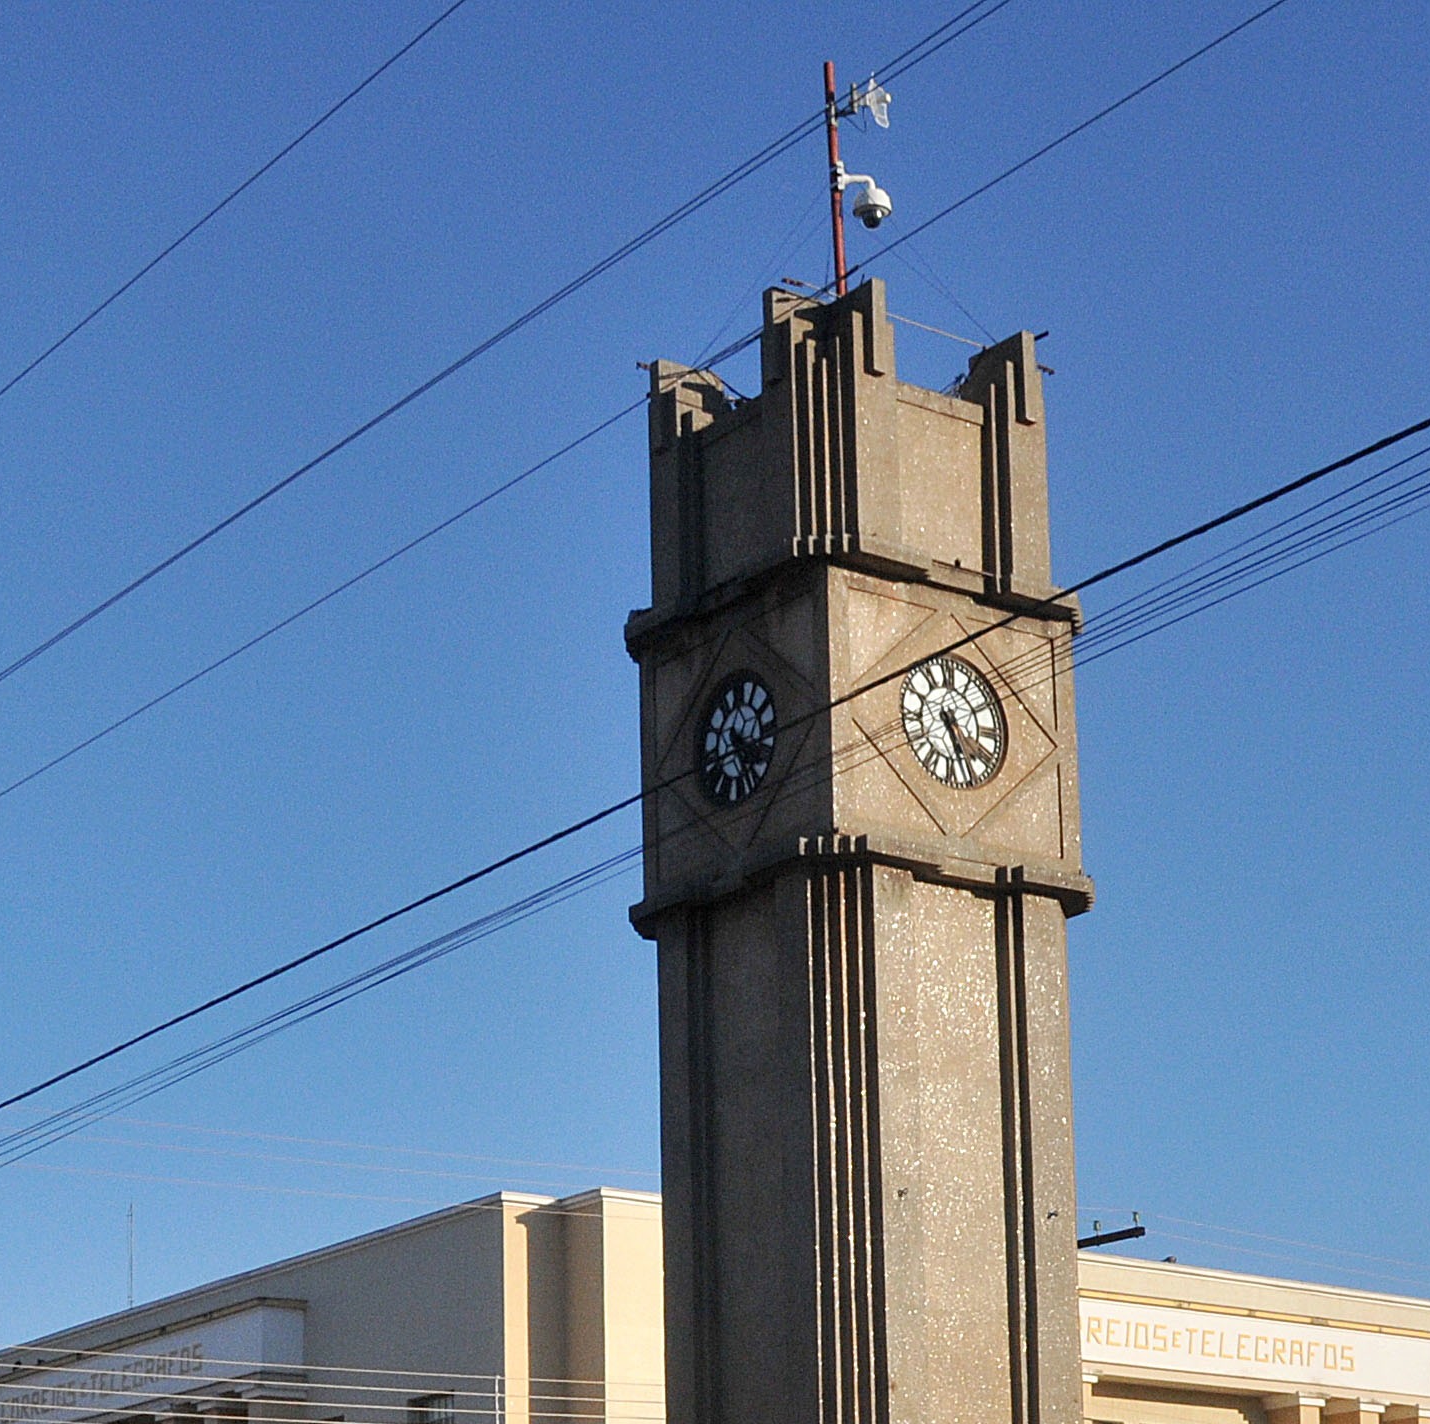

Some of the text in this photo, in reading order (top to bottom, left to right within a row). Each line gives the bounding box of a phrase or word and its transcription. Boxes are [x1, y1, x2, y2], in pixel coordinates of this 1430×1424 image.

[1086, 1316, 1356, 1373] REIOS E TELEGRAFOS
